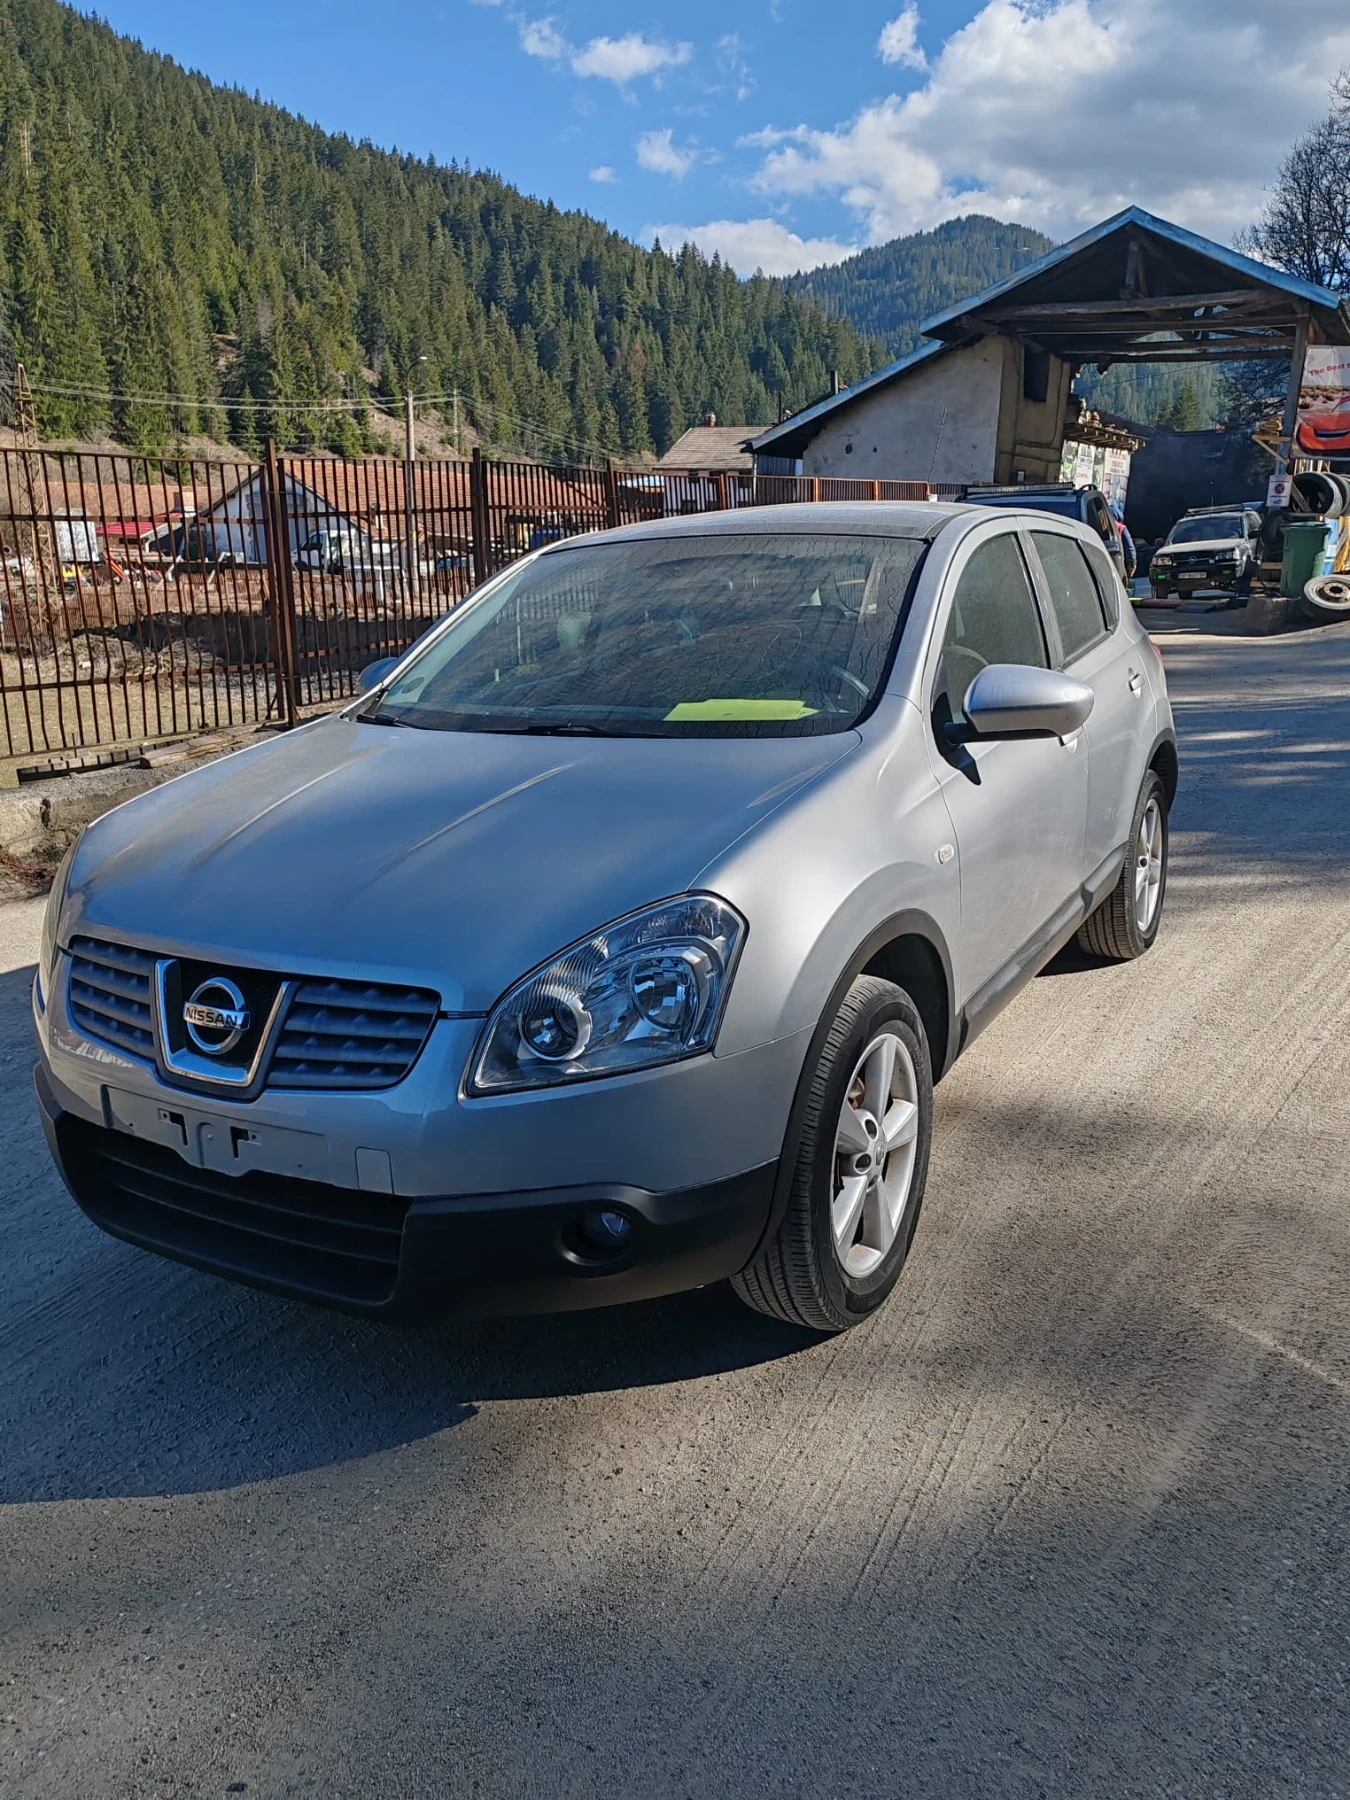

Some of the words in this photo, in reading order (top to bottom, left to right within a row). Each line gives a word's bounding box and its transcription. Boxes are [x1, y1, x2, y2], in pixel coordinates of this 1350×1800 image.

[1309, 368, 1324, 376] The
[1327, 363, 1344, 371] Best
[186, 1007, 238, 1026] NISSAN
